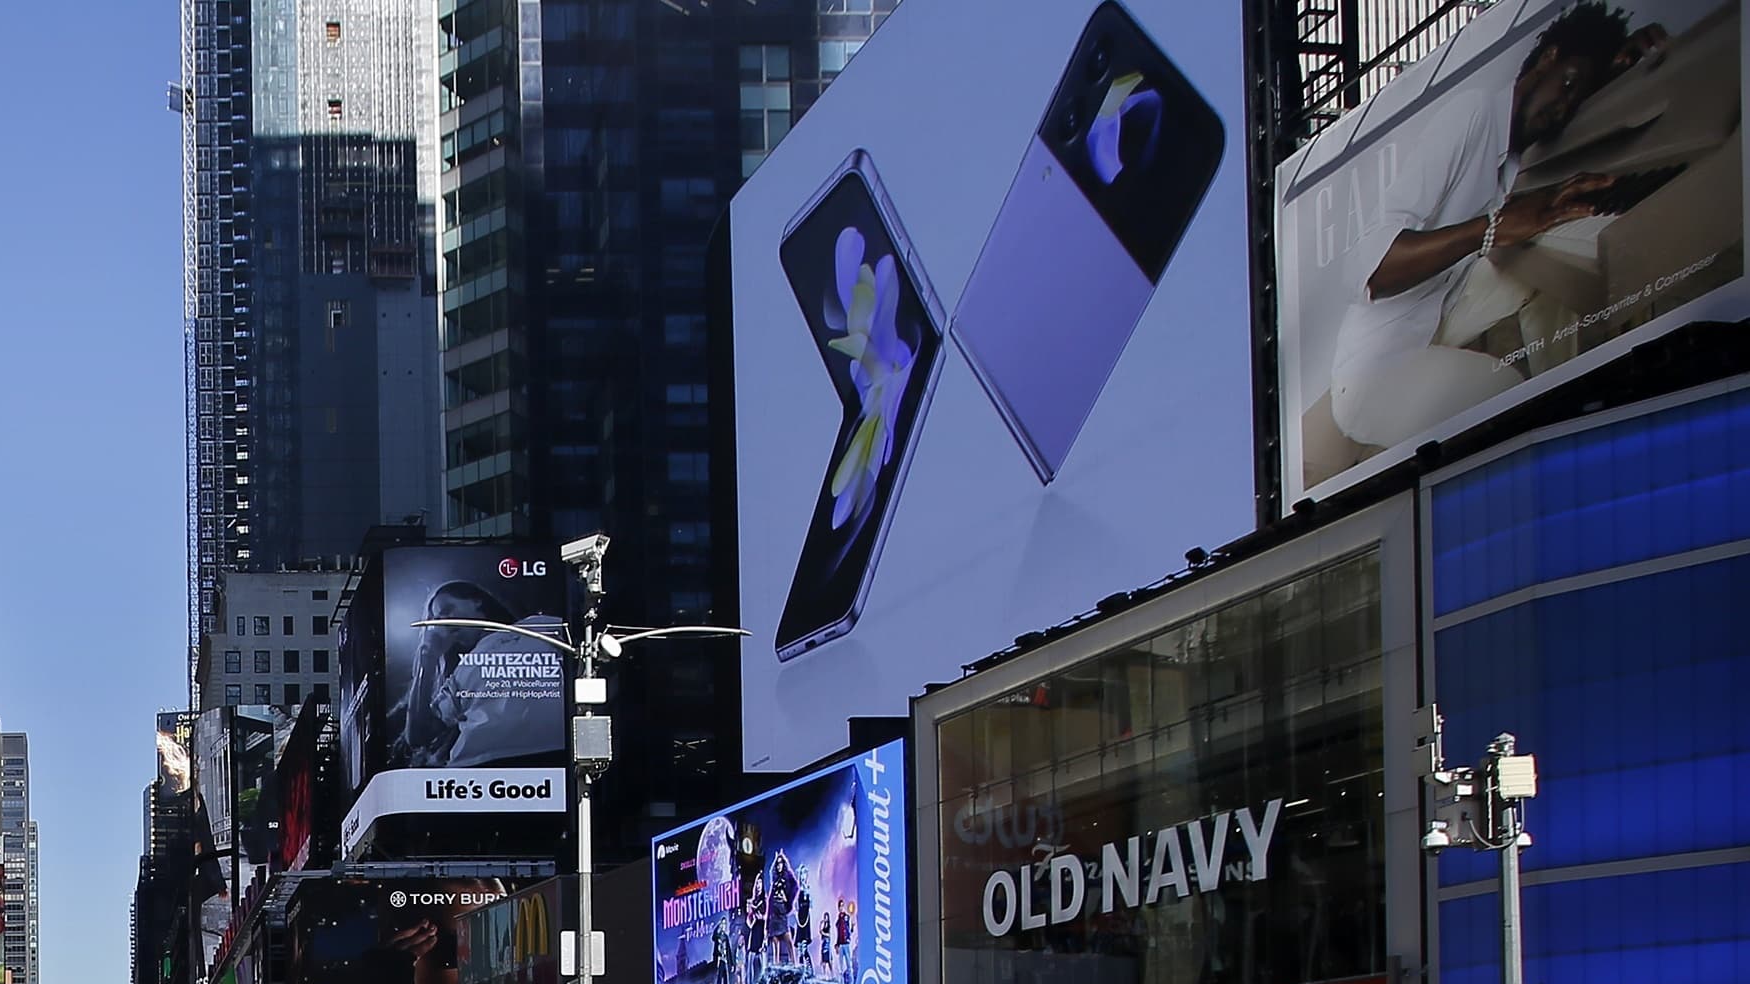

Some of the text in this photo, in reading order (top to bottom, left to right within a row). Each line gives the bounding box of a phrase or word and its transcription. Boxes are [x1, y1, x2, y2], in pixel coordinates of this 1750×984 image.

[1316, 143, 1397, 267] GAP
[1492, 253, 1717, 372] LABRINTH Artist-Songwriter & Composer
[522, 561, 547, 576] LG
[481, 667, 560, 678] MARTINEZ
[485, 680, 501, 688] Age
[512, 680, 560, 688] #VoiceRunner
[456, 690, 561, 699] #ClimateActivist #HipHopArtist
[425, 780, 552, 799] Life's Good
[983, 853, 1085, 937] OLD
[1102, 798, 1283, 915] NAVY
[410, 893, 508, 905] TORY BUR
[663, 891, 711, 930] MONSTER
[712, 877, 740, 914] HIGH
